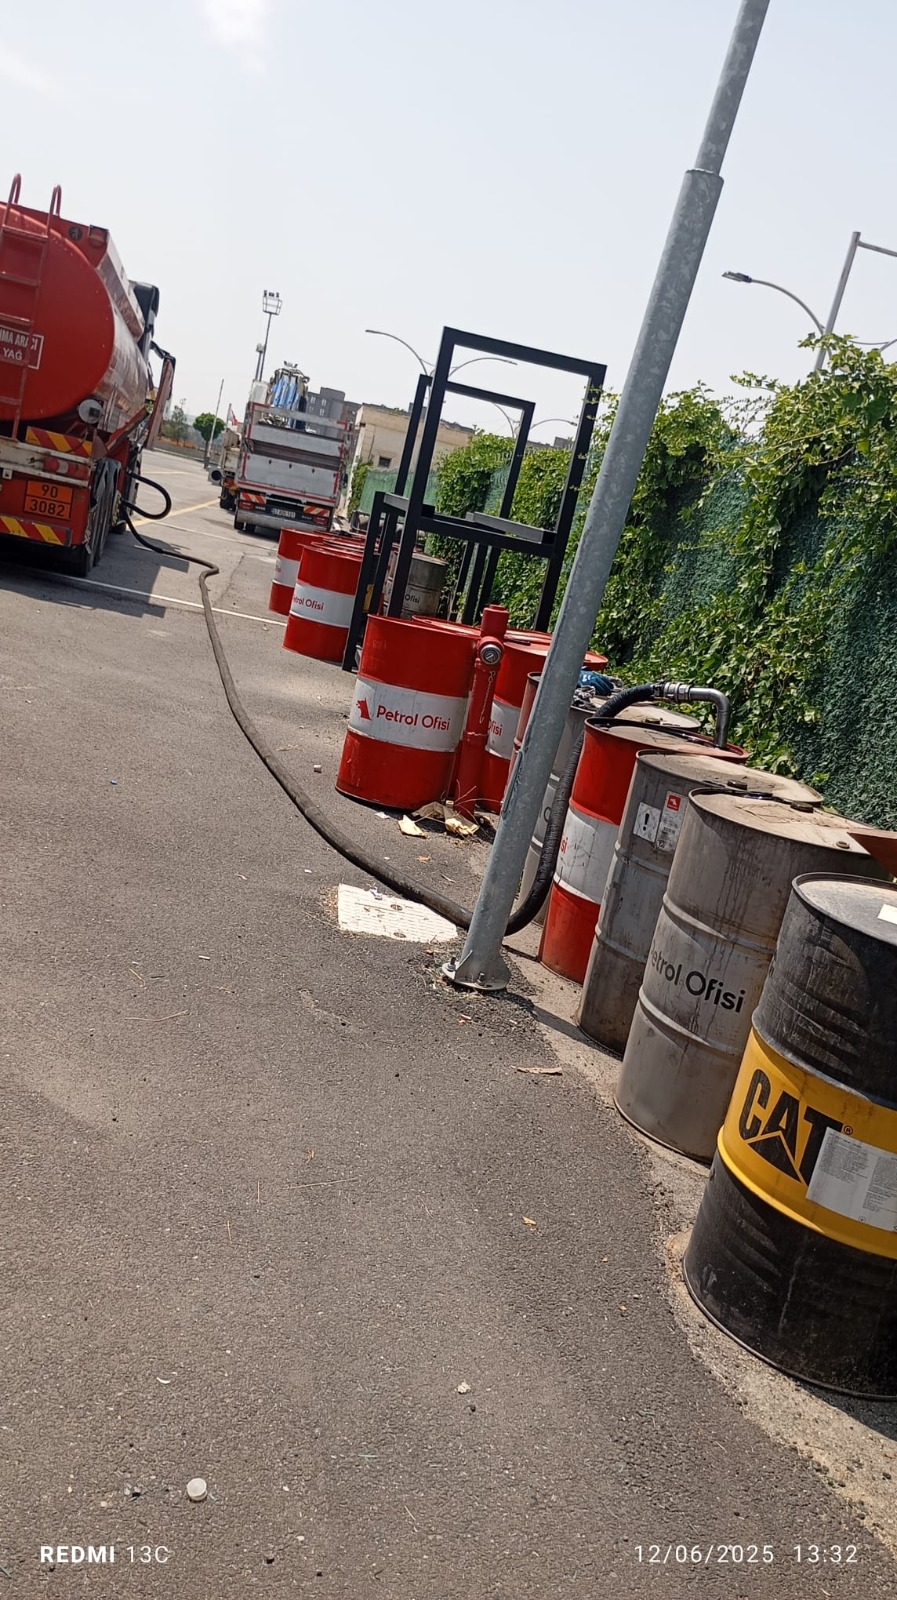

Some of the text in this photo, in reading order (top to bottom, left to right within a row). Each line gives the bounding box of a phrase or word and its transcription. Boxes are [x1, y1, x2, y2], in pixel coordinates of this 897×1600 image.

[42, 484, 59, 499] 90
[29, 499, 66, 517] 3082
[305, 599, 325, 611] Ofisi
[376, 705, 451, 731] Petrol Ofisi
[685, 970, 746, 1013] Ofisi
